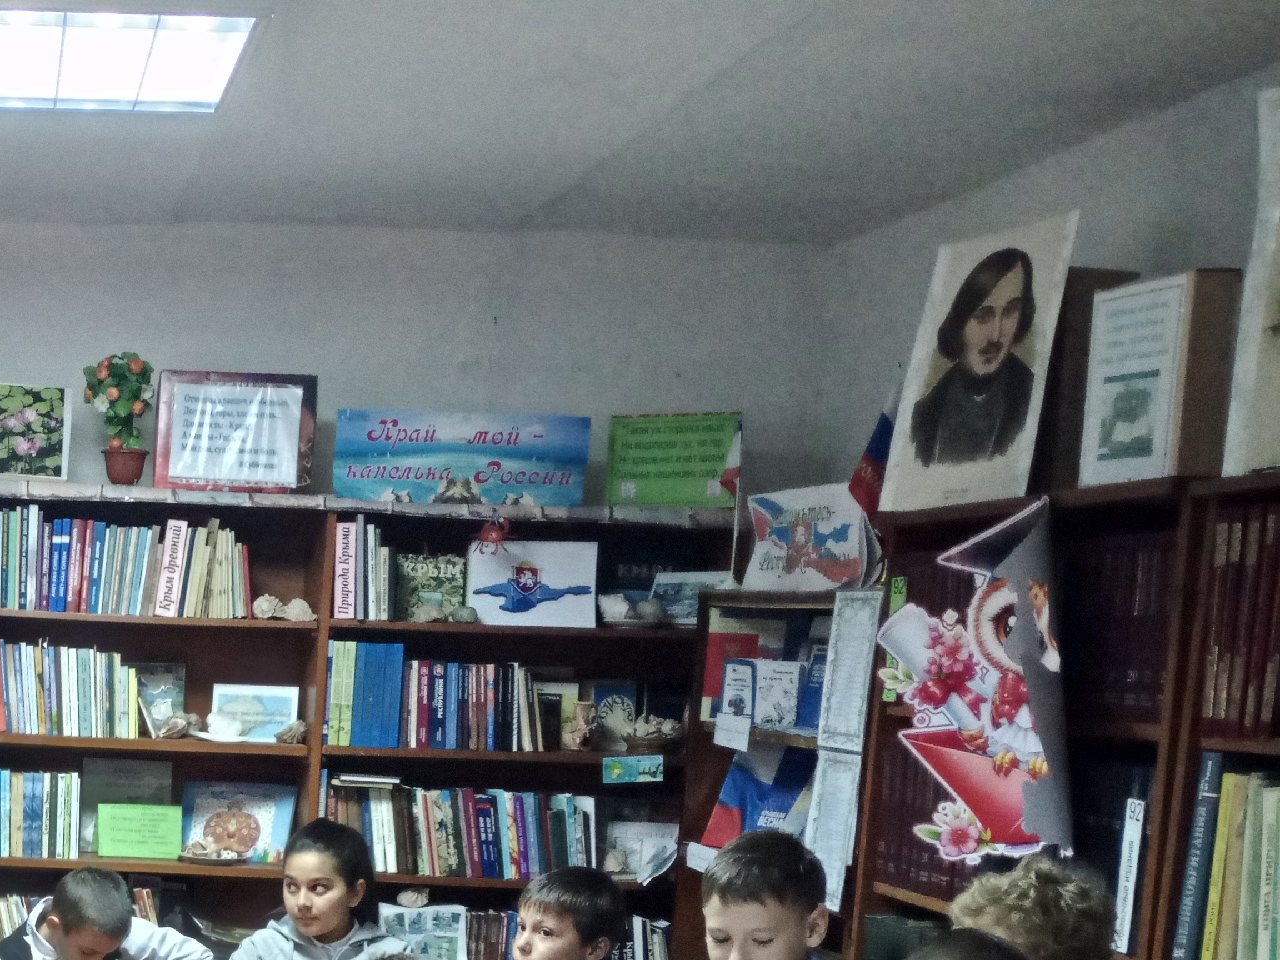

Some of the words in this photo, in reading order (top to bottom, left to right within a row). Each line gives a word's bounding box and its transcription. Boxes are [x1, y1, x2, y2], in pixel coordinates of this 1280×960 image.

[367, 418, 436, 449] Край
[467, 426, 520, 446] мой
[346, 464, 452, 480] капелька
[474, 461, 572, 485] России
[163, 525, 182, 574] древний
[339, 526, 353, 564] Крыма
[403, 562, 461, 577] КРЫМ
[159, 577, 174, 611] Крым
[338, 564, 352, 614] Природа
[893, 579, 904, 595] 92
[1128, 800, 1144, 822] 92
